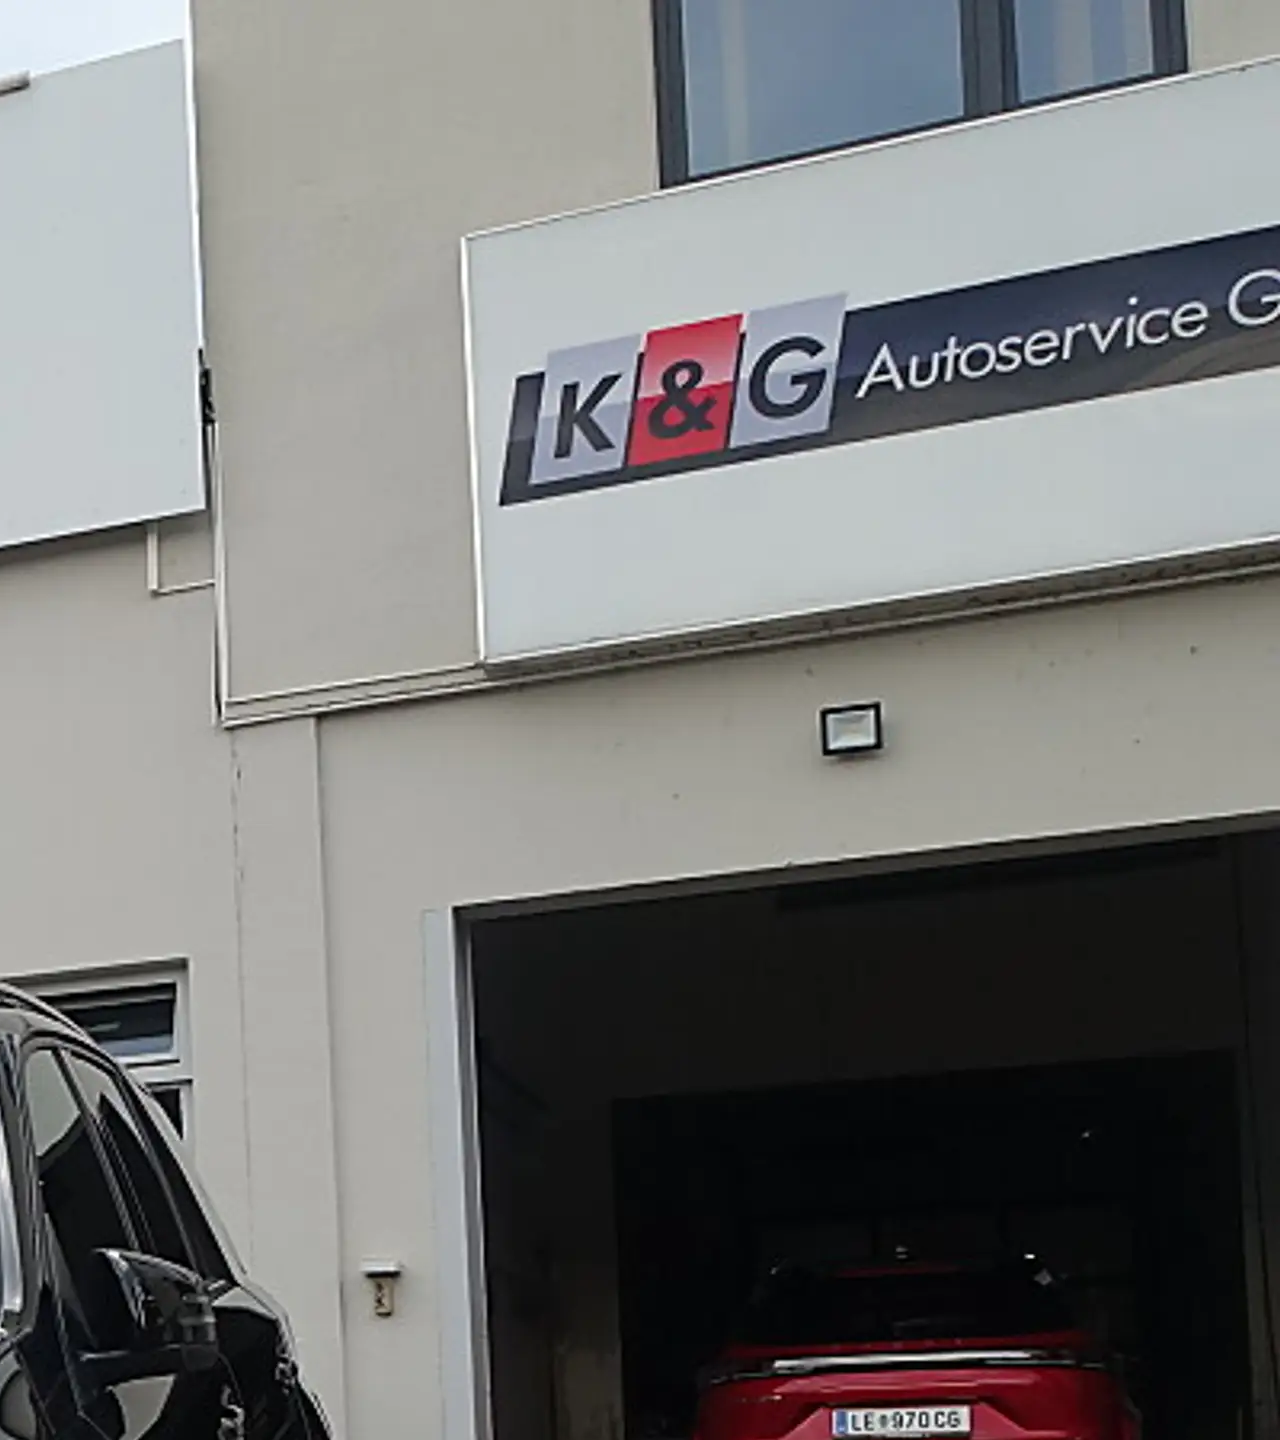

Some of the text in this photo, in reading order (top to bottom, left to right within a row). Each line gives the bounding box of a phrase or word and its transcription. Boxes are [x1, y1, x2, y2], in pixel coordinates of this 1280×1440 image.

[553, 337, 826, 459] K&G
[856, 297, 1208, 399] Autoservice
[892, 1410, 930, 1429] 970
